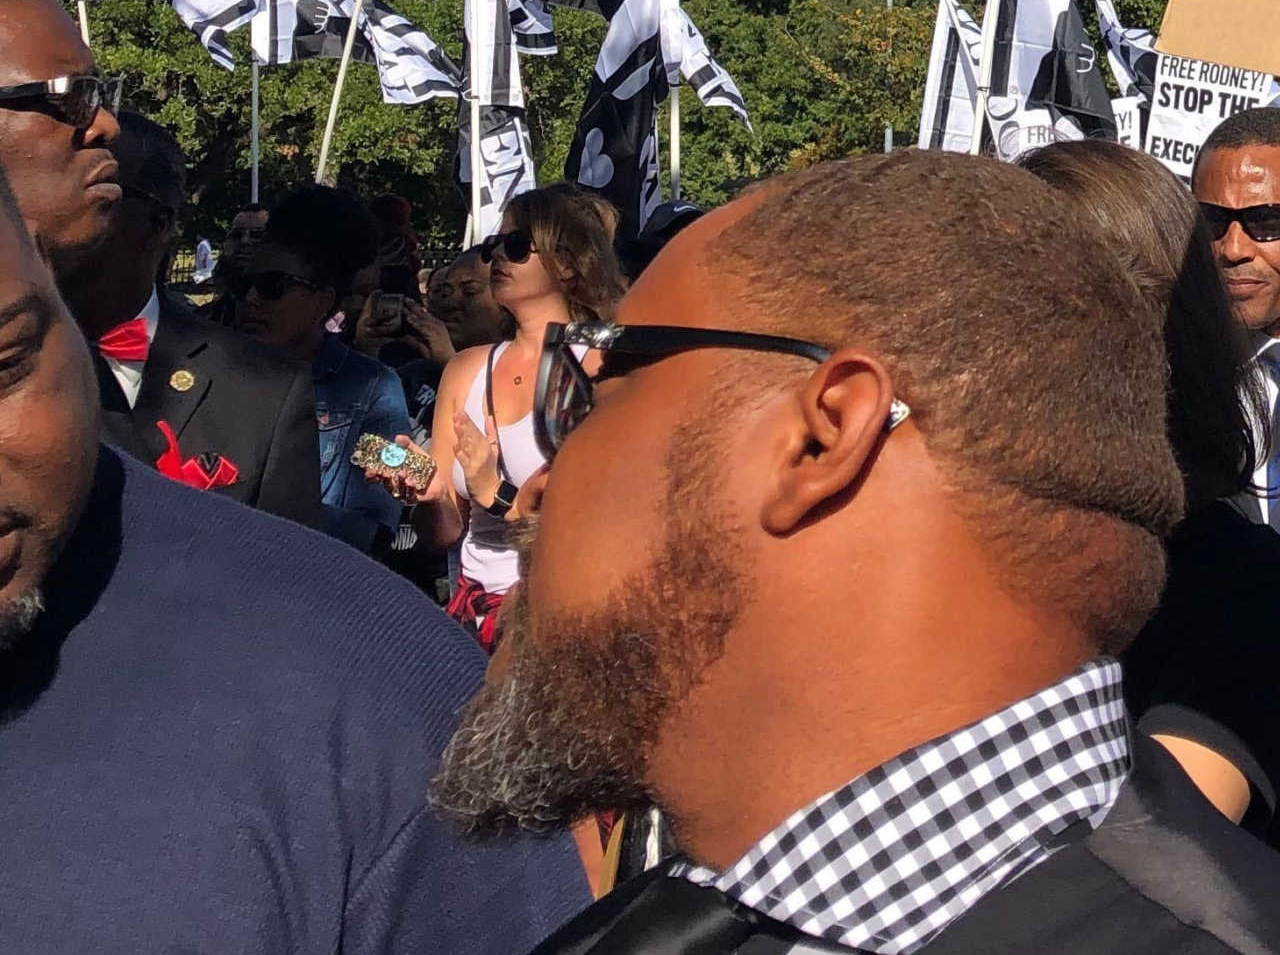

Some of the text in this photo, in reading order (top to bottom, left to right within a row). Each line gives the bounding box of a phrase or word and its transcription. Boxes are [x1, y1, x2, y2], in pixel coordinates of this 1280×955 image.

[1160, 55, 1267, 93] FREE RODNEY!
[1158, 82, 1213, 115] STOP
